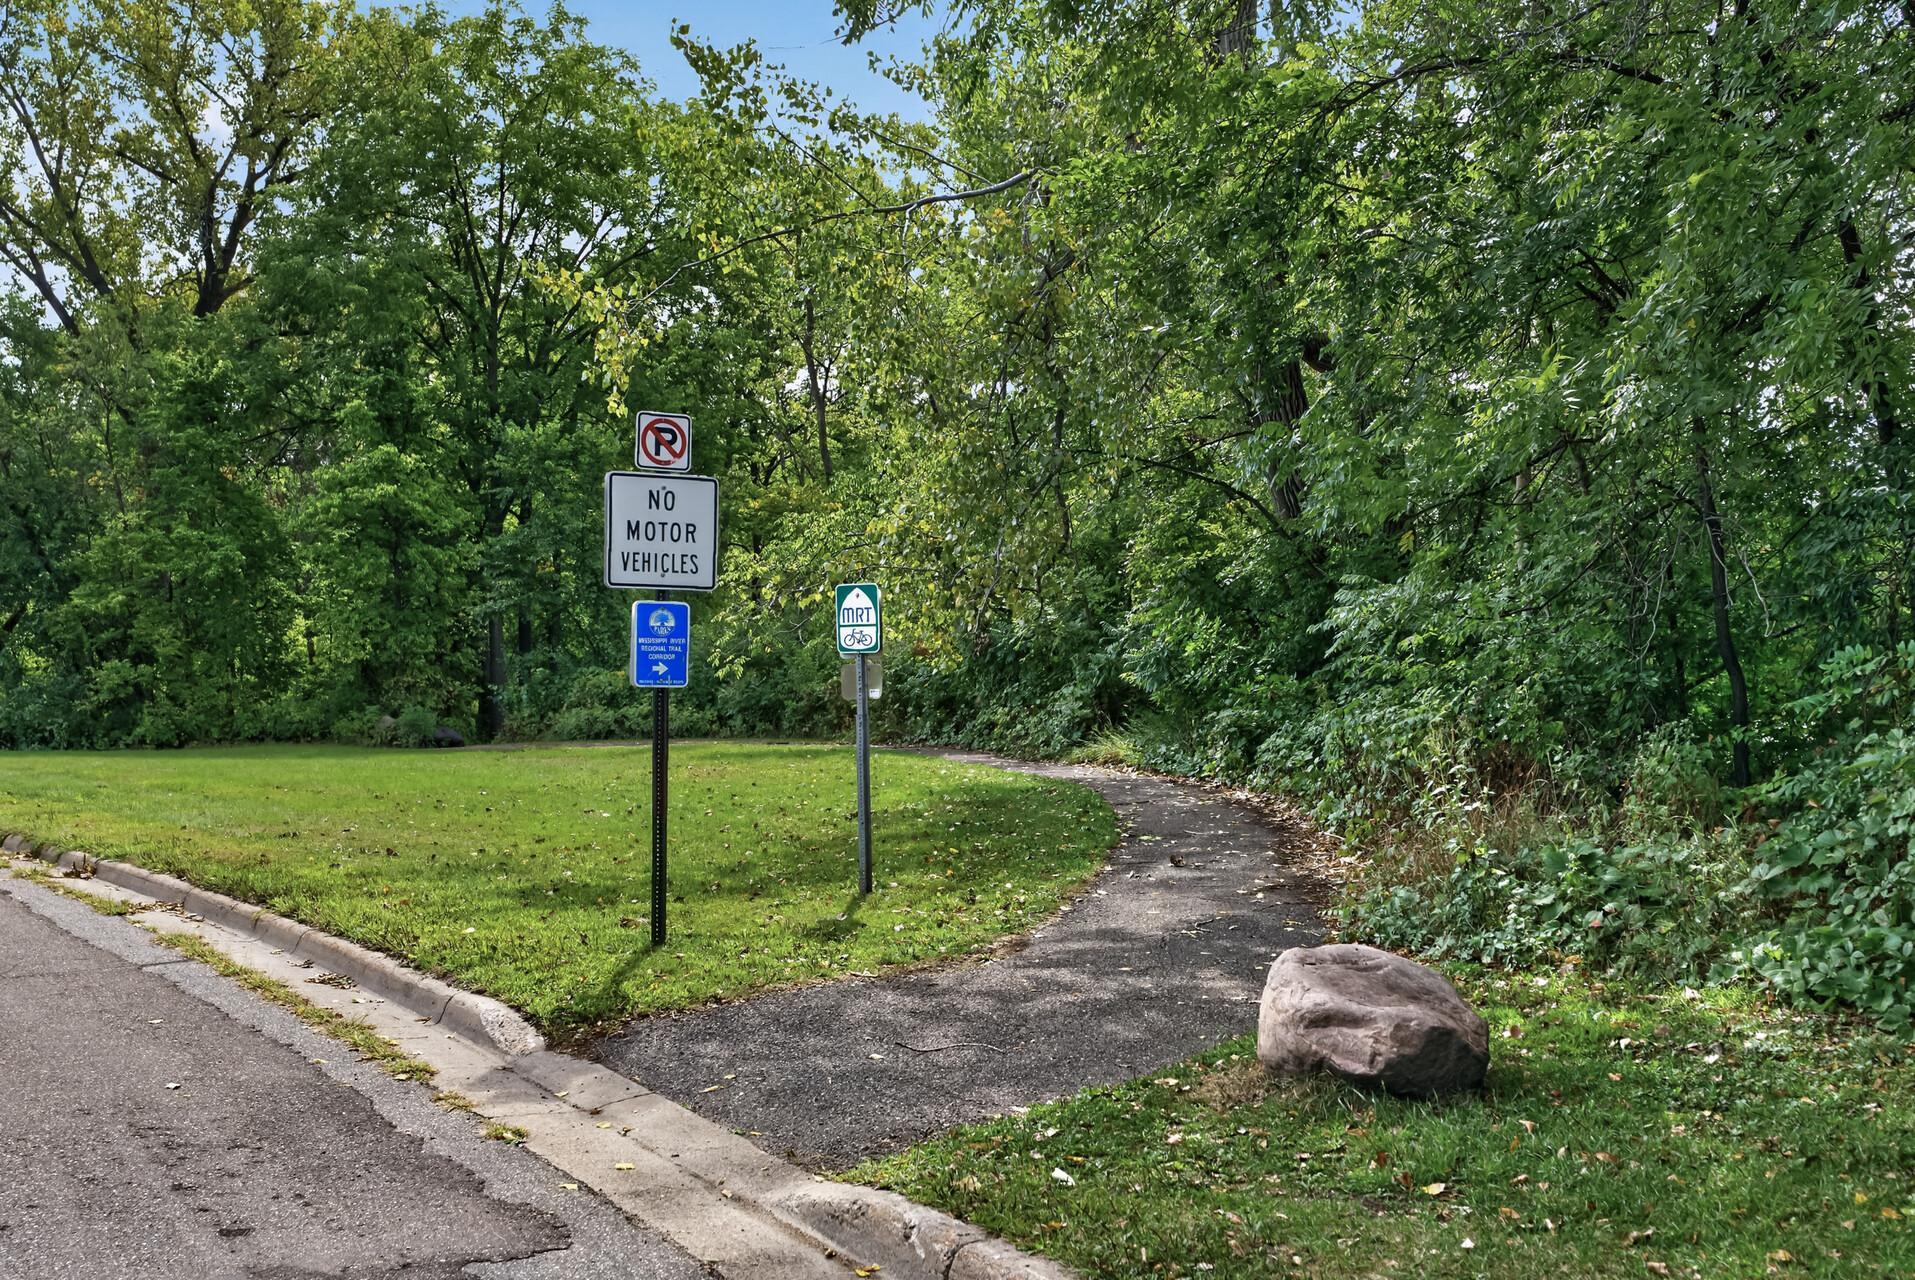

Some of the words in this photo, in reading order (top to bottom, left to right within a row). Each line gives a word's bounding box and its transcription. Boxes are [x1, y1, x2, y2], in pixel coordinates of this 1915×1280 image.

[648, 489, 676, 511] NO
[626, 519, 697, 543] MOTOR
[621, 551, 699, 574] VEHICLES
[842, 607, 872, 623] MRT
